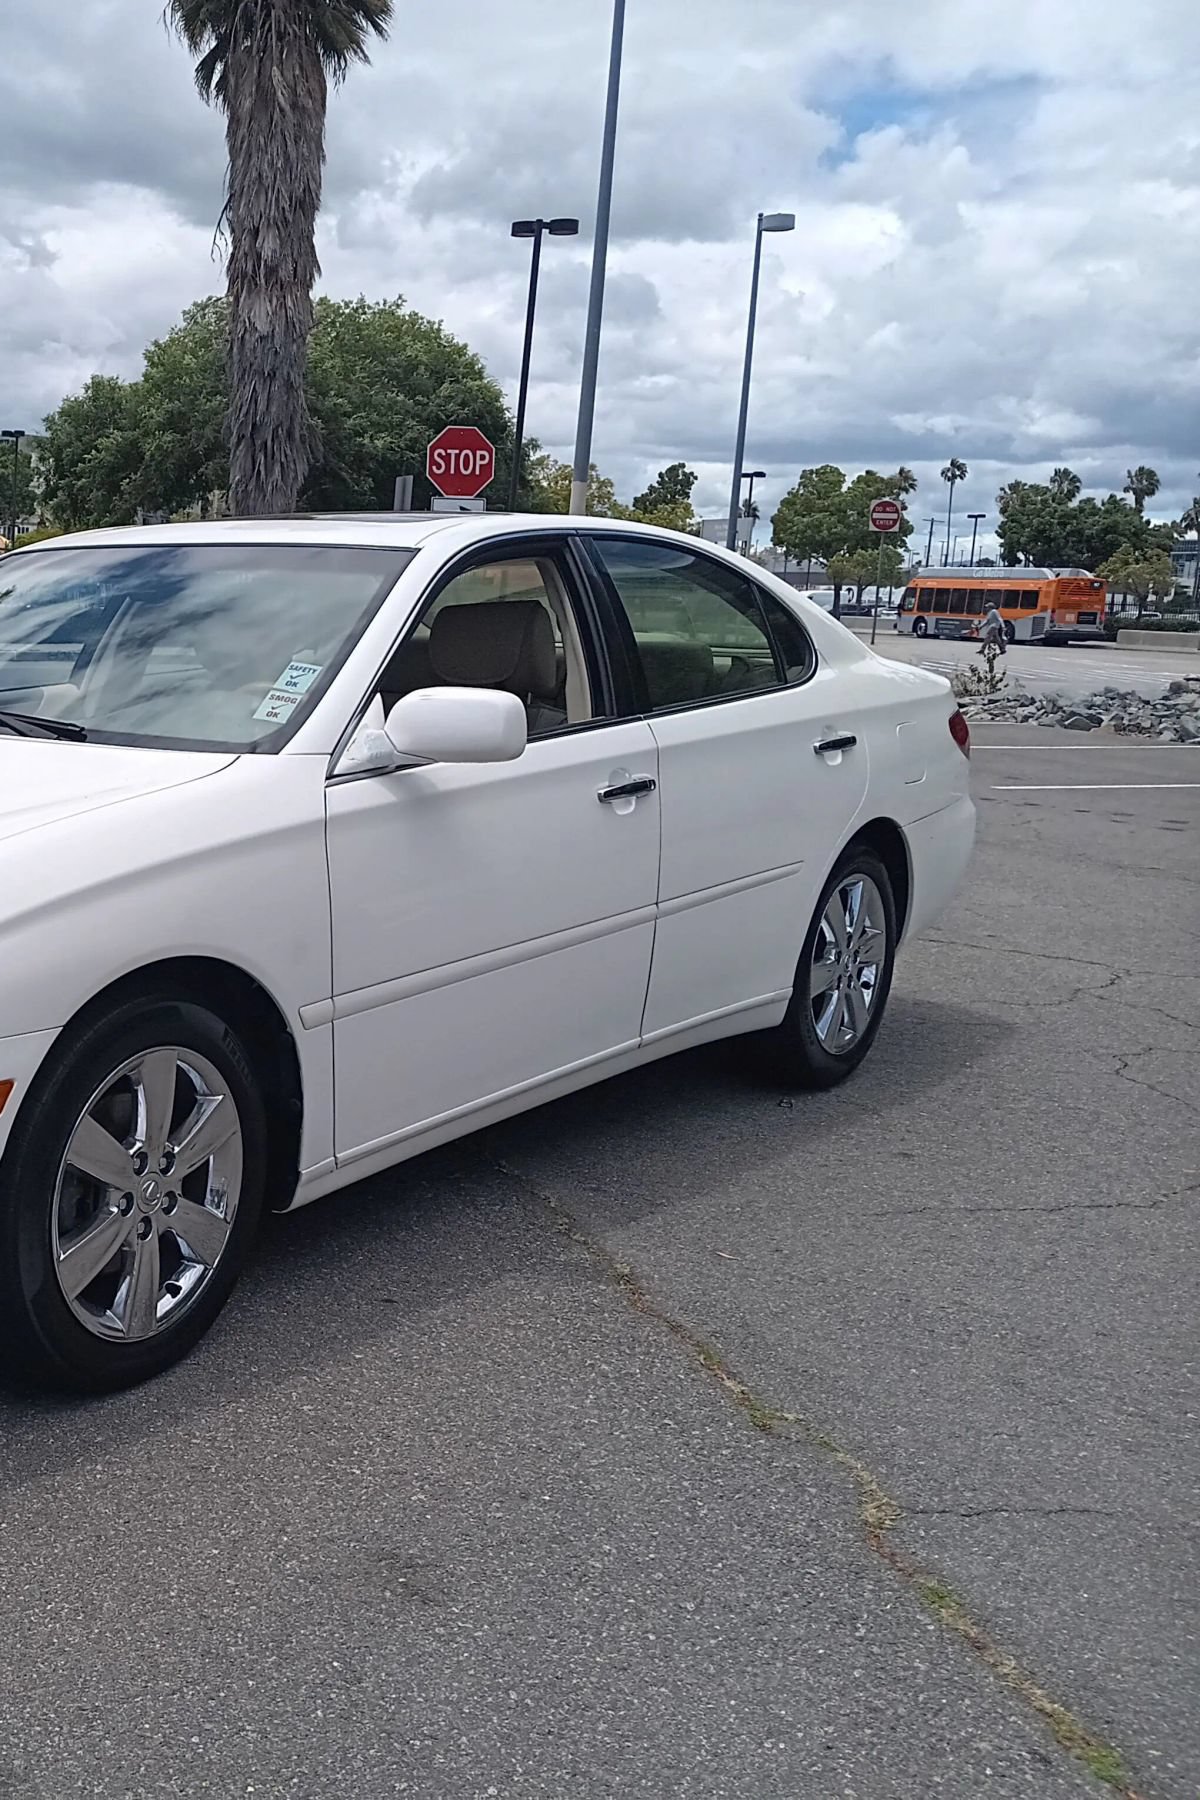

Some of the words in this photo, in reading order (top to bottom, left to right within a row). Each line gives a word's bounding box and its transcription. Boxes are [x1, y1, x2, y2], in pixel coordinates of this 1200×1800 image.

[432, 448, 490, 476] STOP
[288, 664, 318, 674] SAFETY
[285, 680, 299, 688] OK
[268, 693, 298, 704] SMOG
[266, 710, 280, 719] OK
